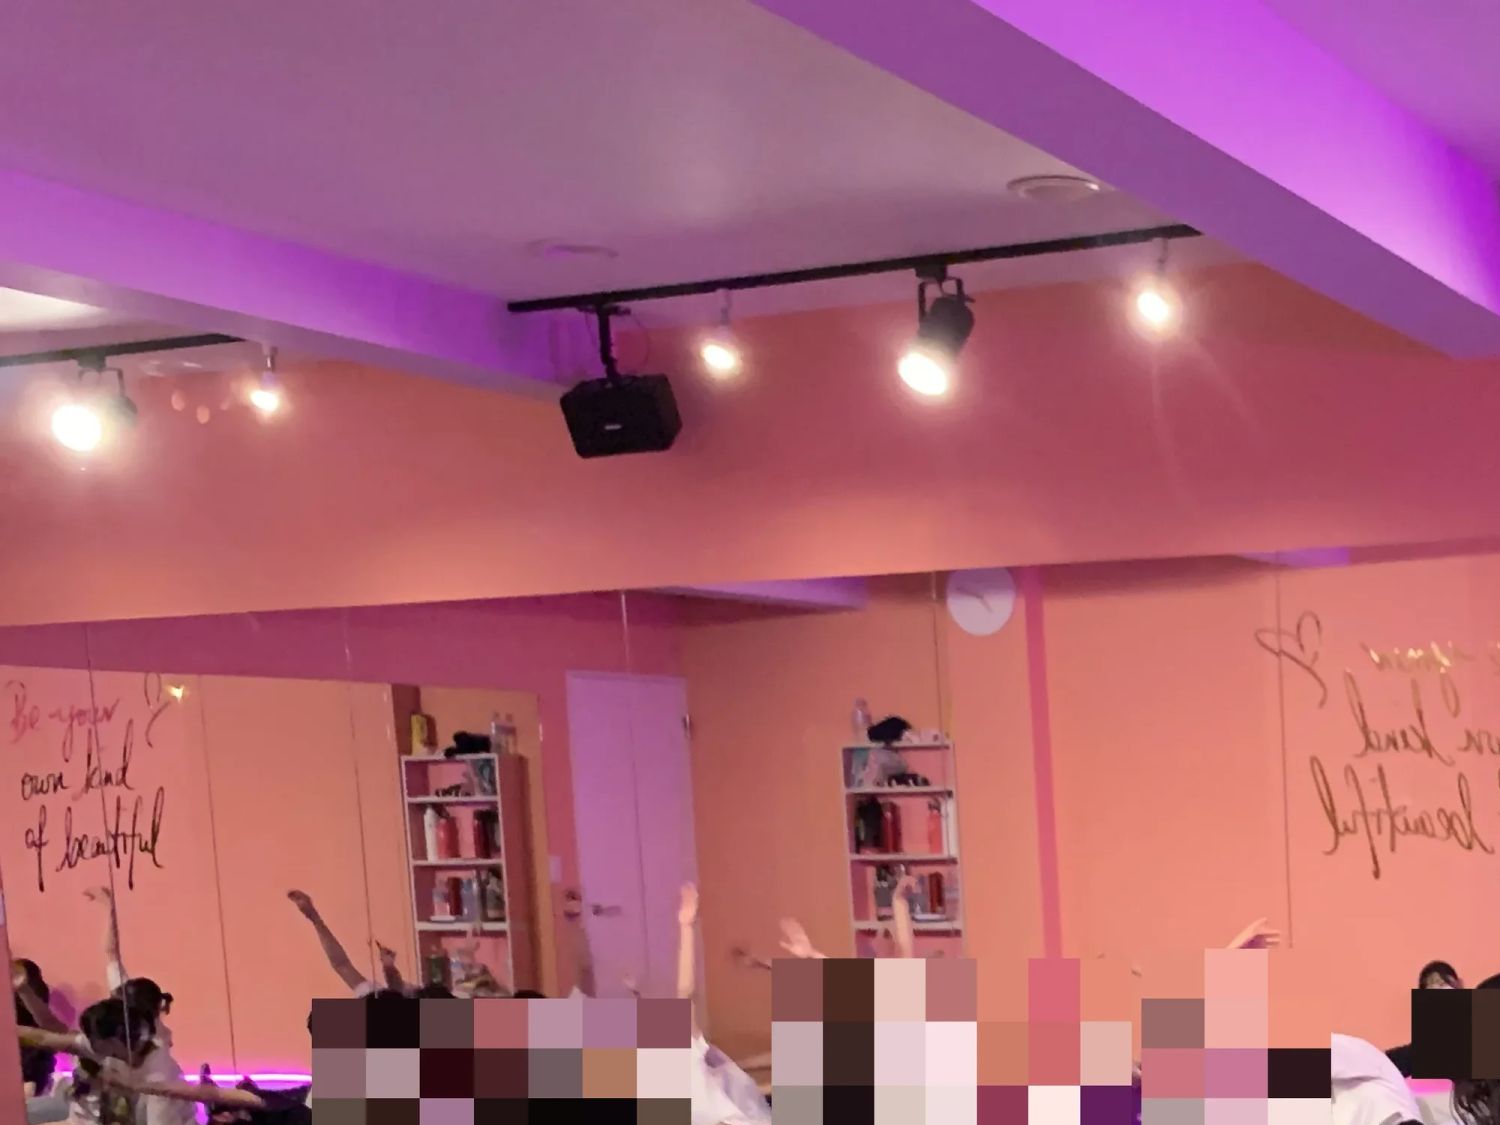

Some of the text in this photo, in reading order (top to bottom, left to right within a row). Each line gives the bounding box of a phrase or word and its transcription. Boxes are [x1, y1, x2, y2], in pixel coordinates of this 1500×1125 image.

[6, 679, 120, 763] Be your
[21, 771, 68, 801] own
[24, 786, 165, 892] of beautiful
